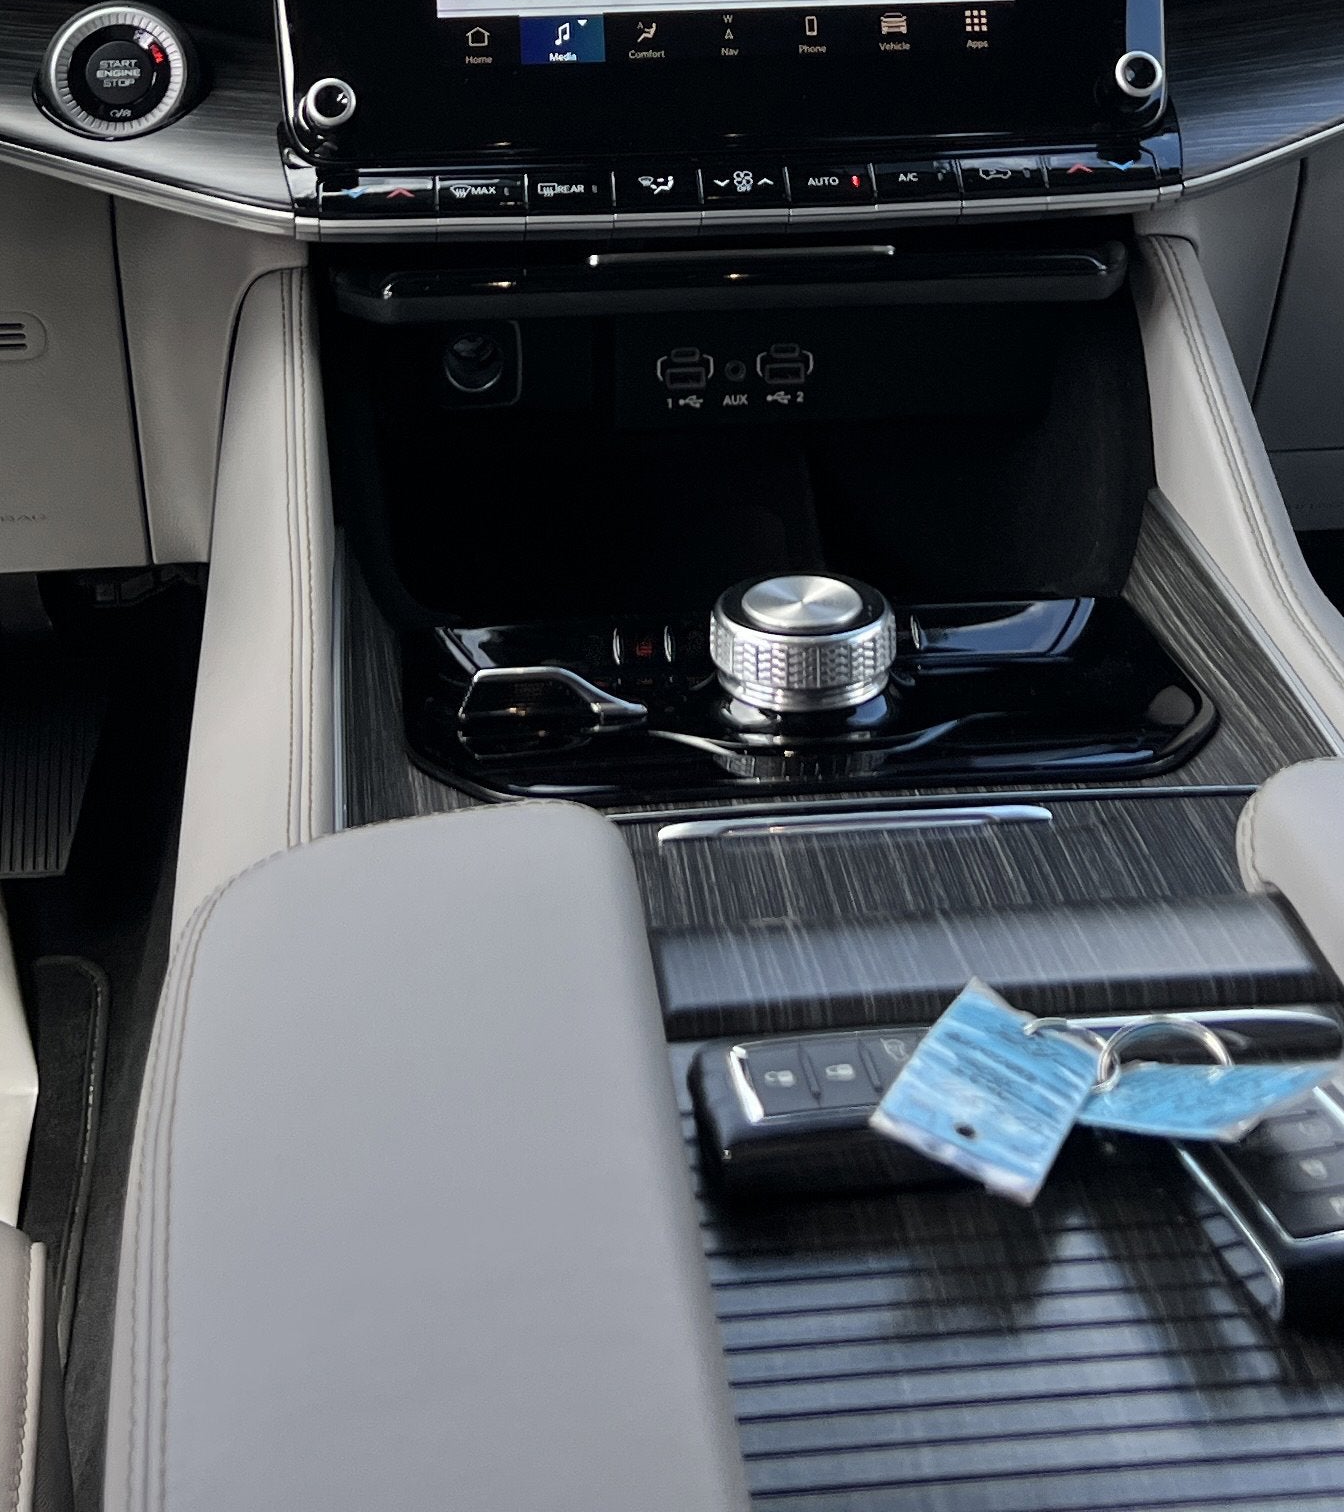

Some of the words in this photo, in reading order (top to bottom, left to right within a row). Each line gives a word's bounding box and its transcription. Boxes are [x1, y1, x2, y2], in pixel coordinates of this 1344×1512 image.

[723, 14, 733, 23] W
[799, 44, 827, 53] Phone
[879, 41, 911, 51] Vehicle
[966, 39, 990, 50] Apps
[628, 49, 666, 59] Comfort
[721, 47, 739, 56] Nav
[465, 54, 493, 64] Home
[549, 52, 577, 62] Media
[99, 59, 138, 69] START
[96, 68, 141, 78] ENGINE
[103, 78, 136, 88] STOP
[808, 175, 839, 186] AUTO
[898, 172, 919, 183] A/C
[471, 186, 496, 195] MAX
[557, 184, 585, 194] REAR
[722, 394, 749, 407] AUX
[796, 391, 804, 403] 2
[666, 398, 673, 409] 1
